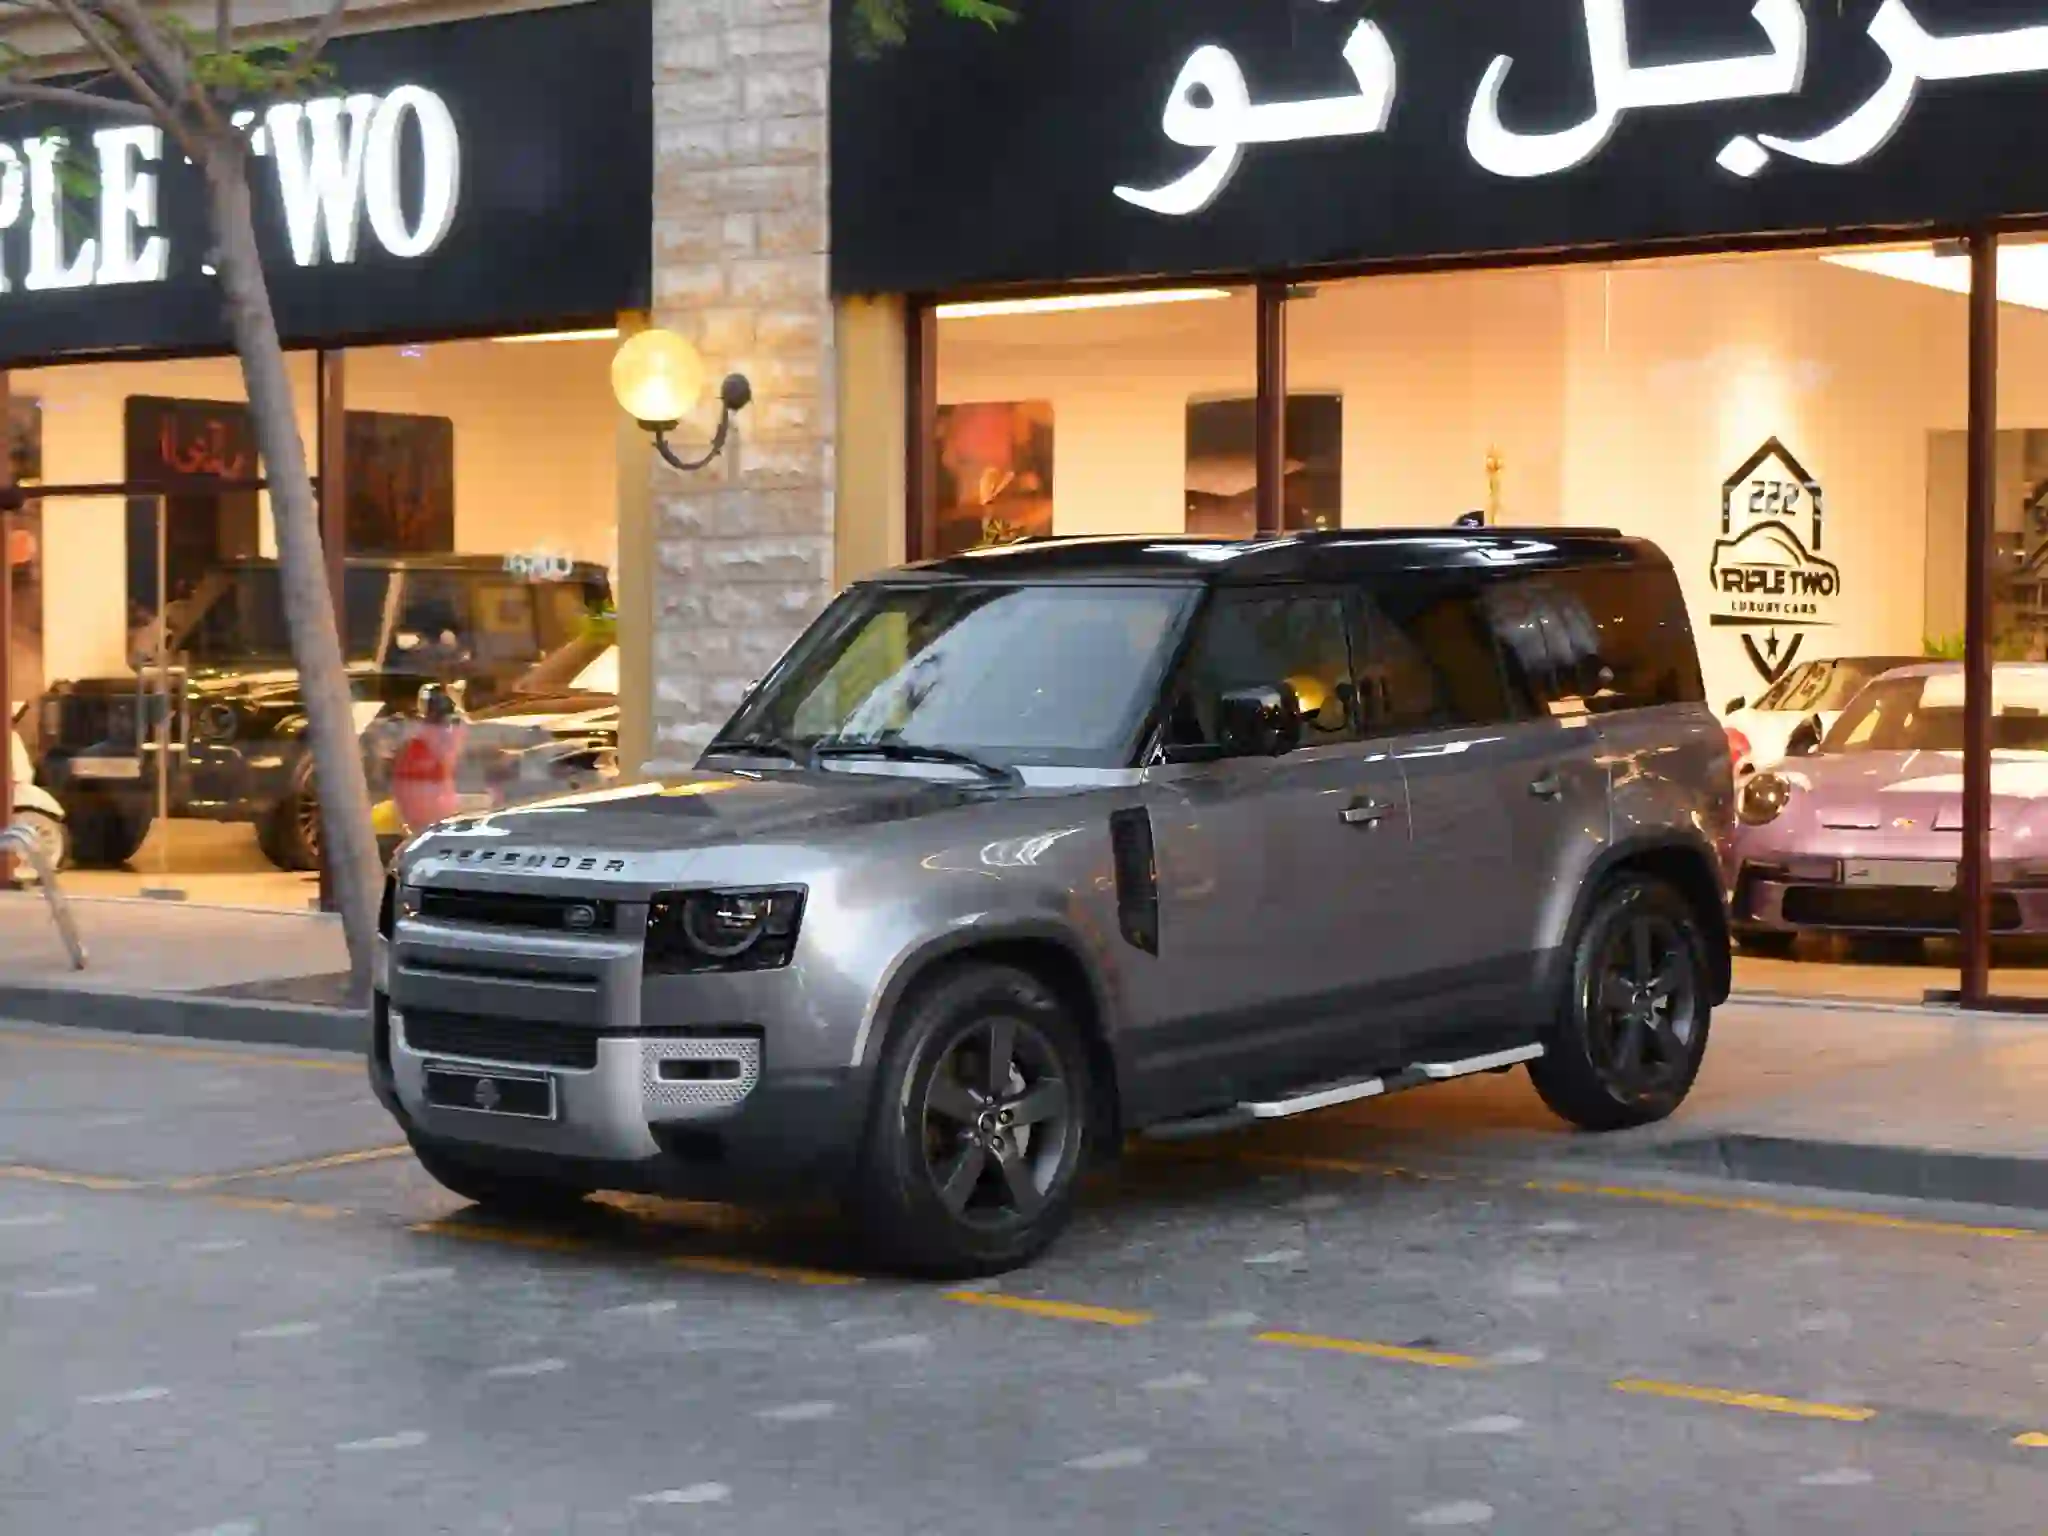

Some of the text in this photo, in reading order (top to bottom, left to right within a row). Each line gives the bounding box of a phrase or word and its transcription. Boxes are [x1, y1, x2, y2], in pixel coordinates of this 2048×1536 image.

[184, 84, 460, 277] WO
[1790, 570, 1834, 596] TWO
[1731, 600, 1817, 614] LUXURY CARS
[438, 849, 625, 872] DEFENDER
